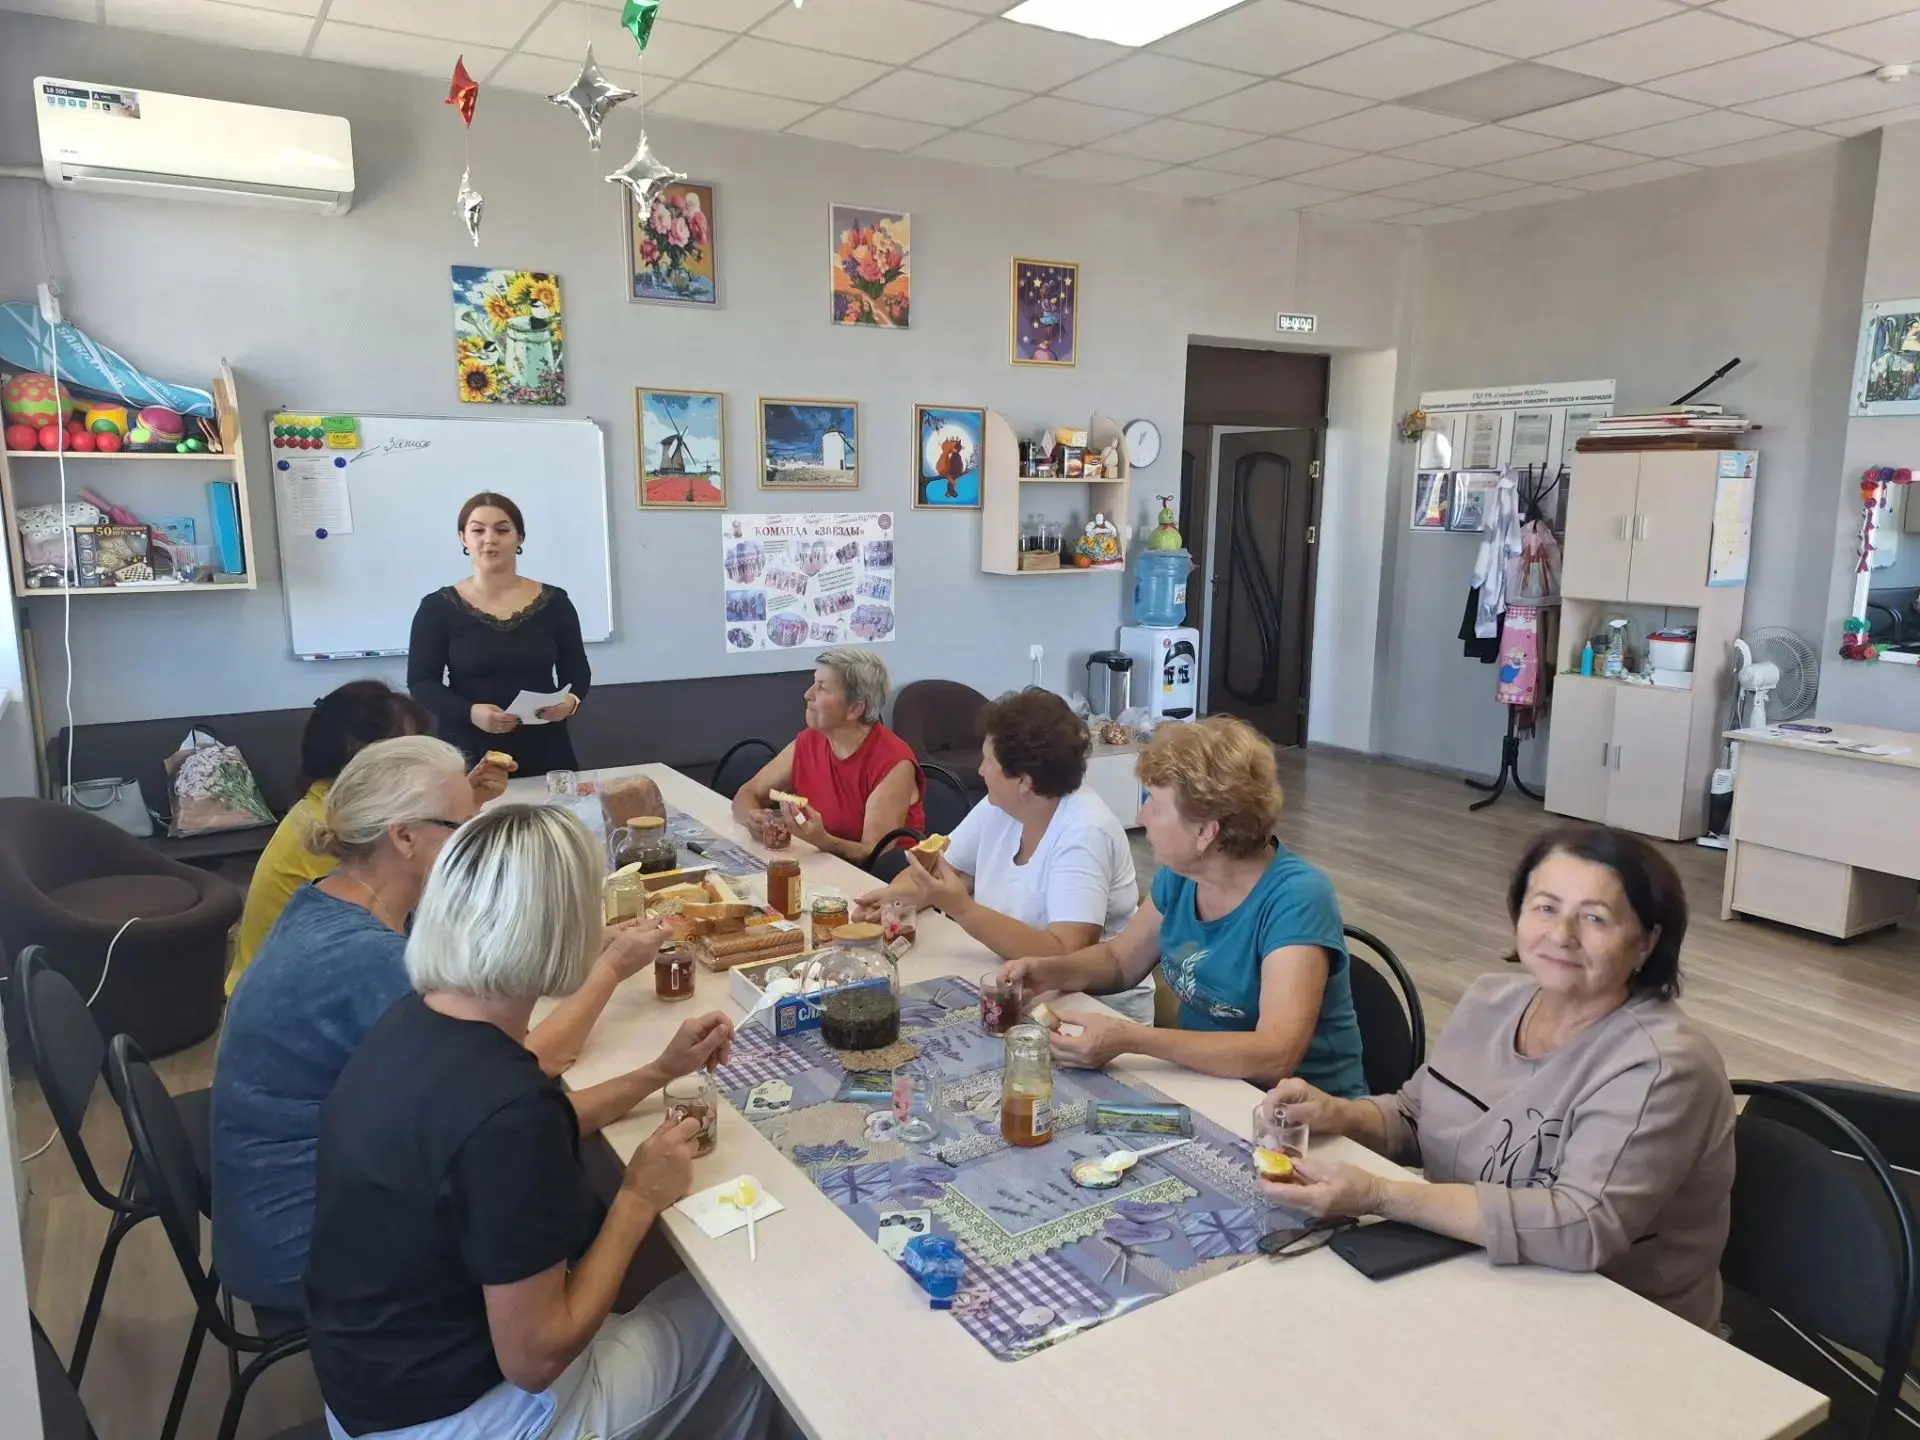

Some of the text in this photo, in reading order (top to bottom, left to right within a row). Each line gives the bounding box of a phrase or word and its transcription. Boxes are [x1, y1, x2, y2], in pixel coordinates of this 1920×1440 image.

[55, 87, 68, 95] 500
[1280, 316, 1312, 330] ВЫХОД
[96, 526, 112, 537] 50
[754, 526, 865, 537] КОМАНДА «ЗВЕЗДЫ»
